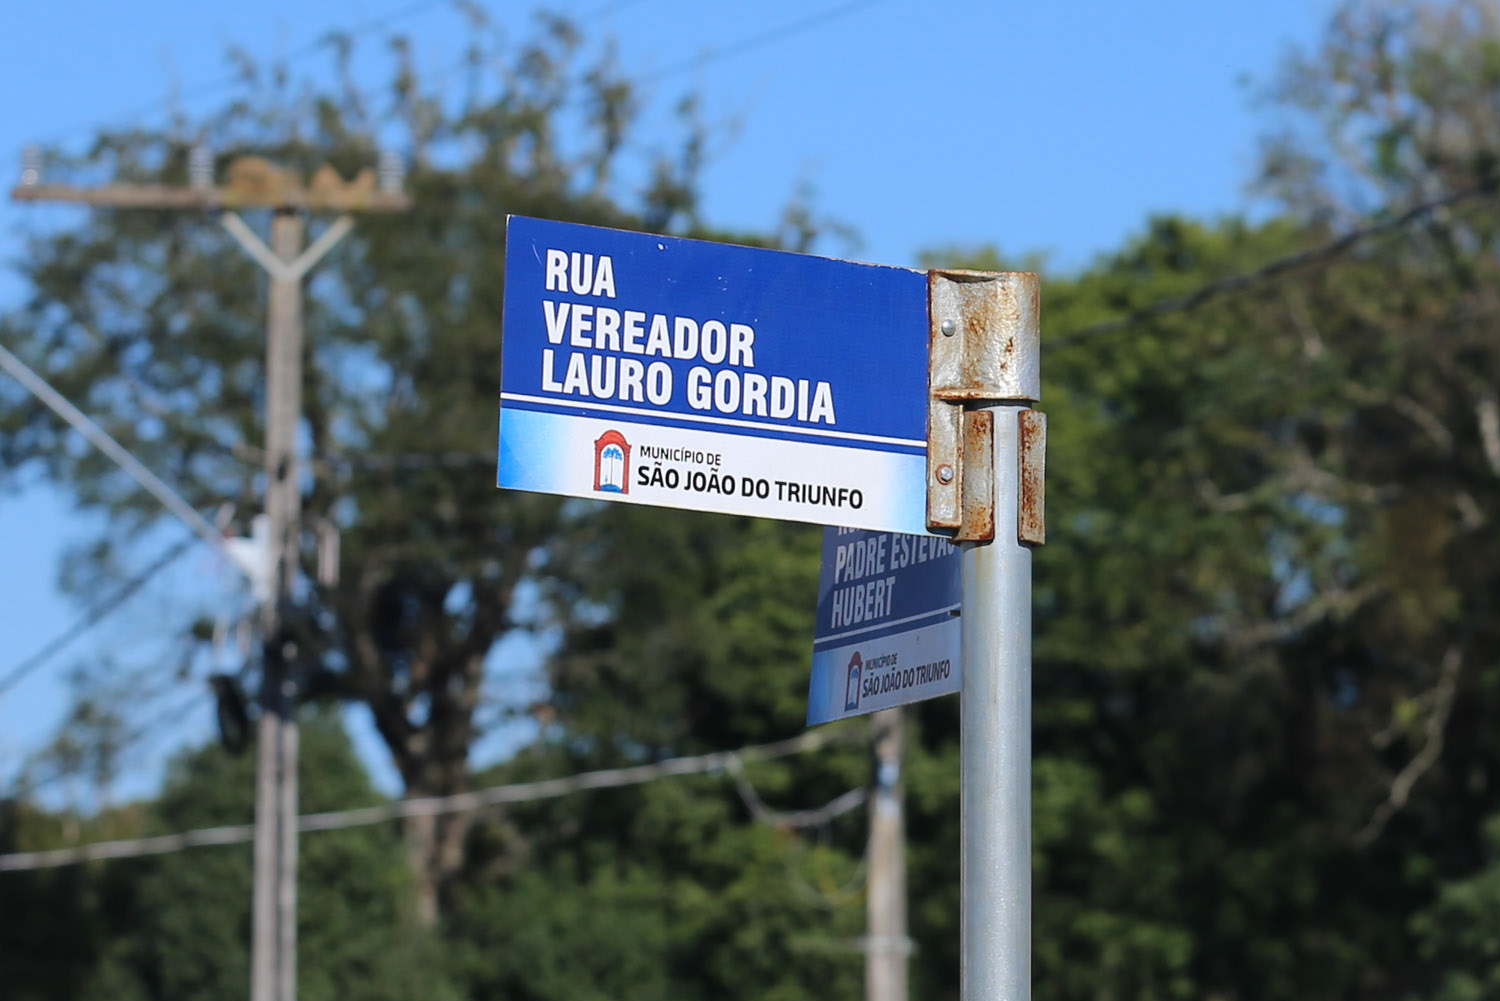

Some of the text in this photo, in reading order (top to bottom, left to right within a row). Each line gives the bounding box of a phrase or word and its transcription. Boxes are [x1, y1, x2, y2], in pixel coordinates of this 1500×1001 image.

[546, 249, 616, 298] RUA
[543, 300, 755, 367] VEREADOR
[542, 349, 836, 424] LAURO GORDIA
[639, 446, 721, 466] MUNICÍPIO DE
[637, 461, 864, 509] SÃO JOÃO DO TRIUNFO
[835, 534, 888, 584] PADRE
[831, 576, 896, 629] HUBERT
[862, 659, 951, 698] SÃO JOÃO DO TRIUNFO
